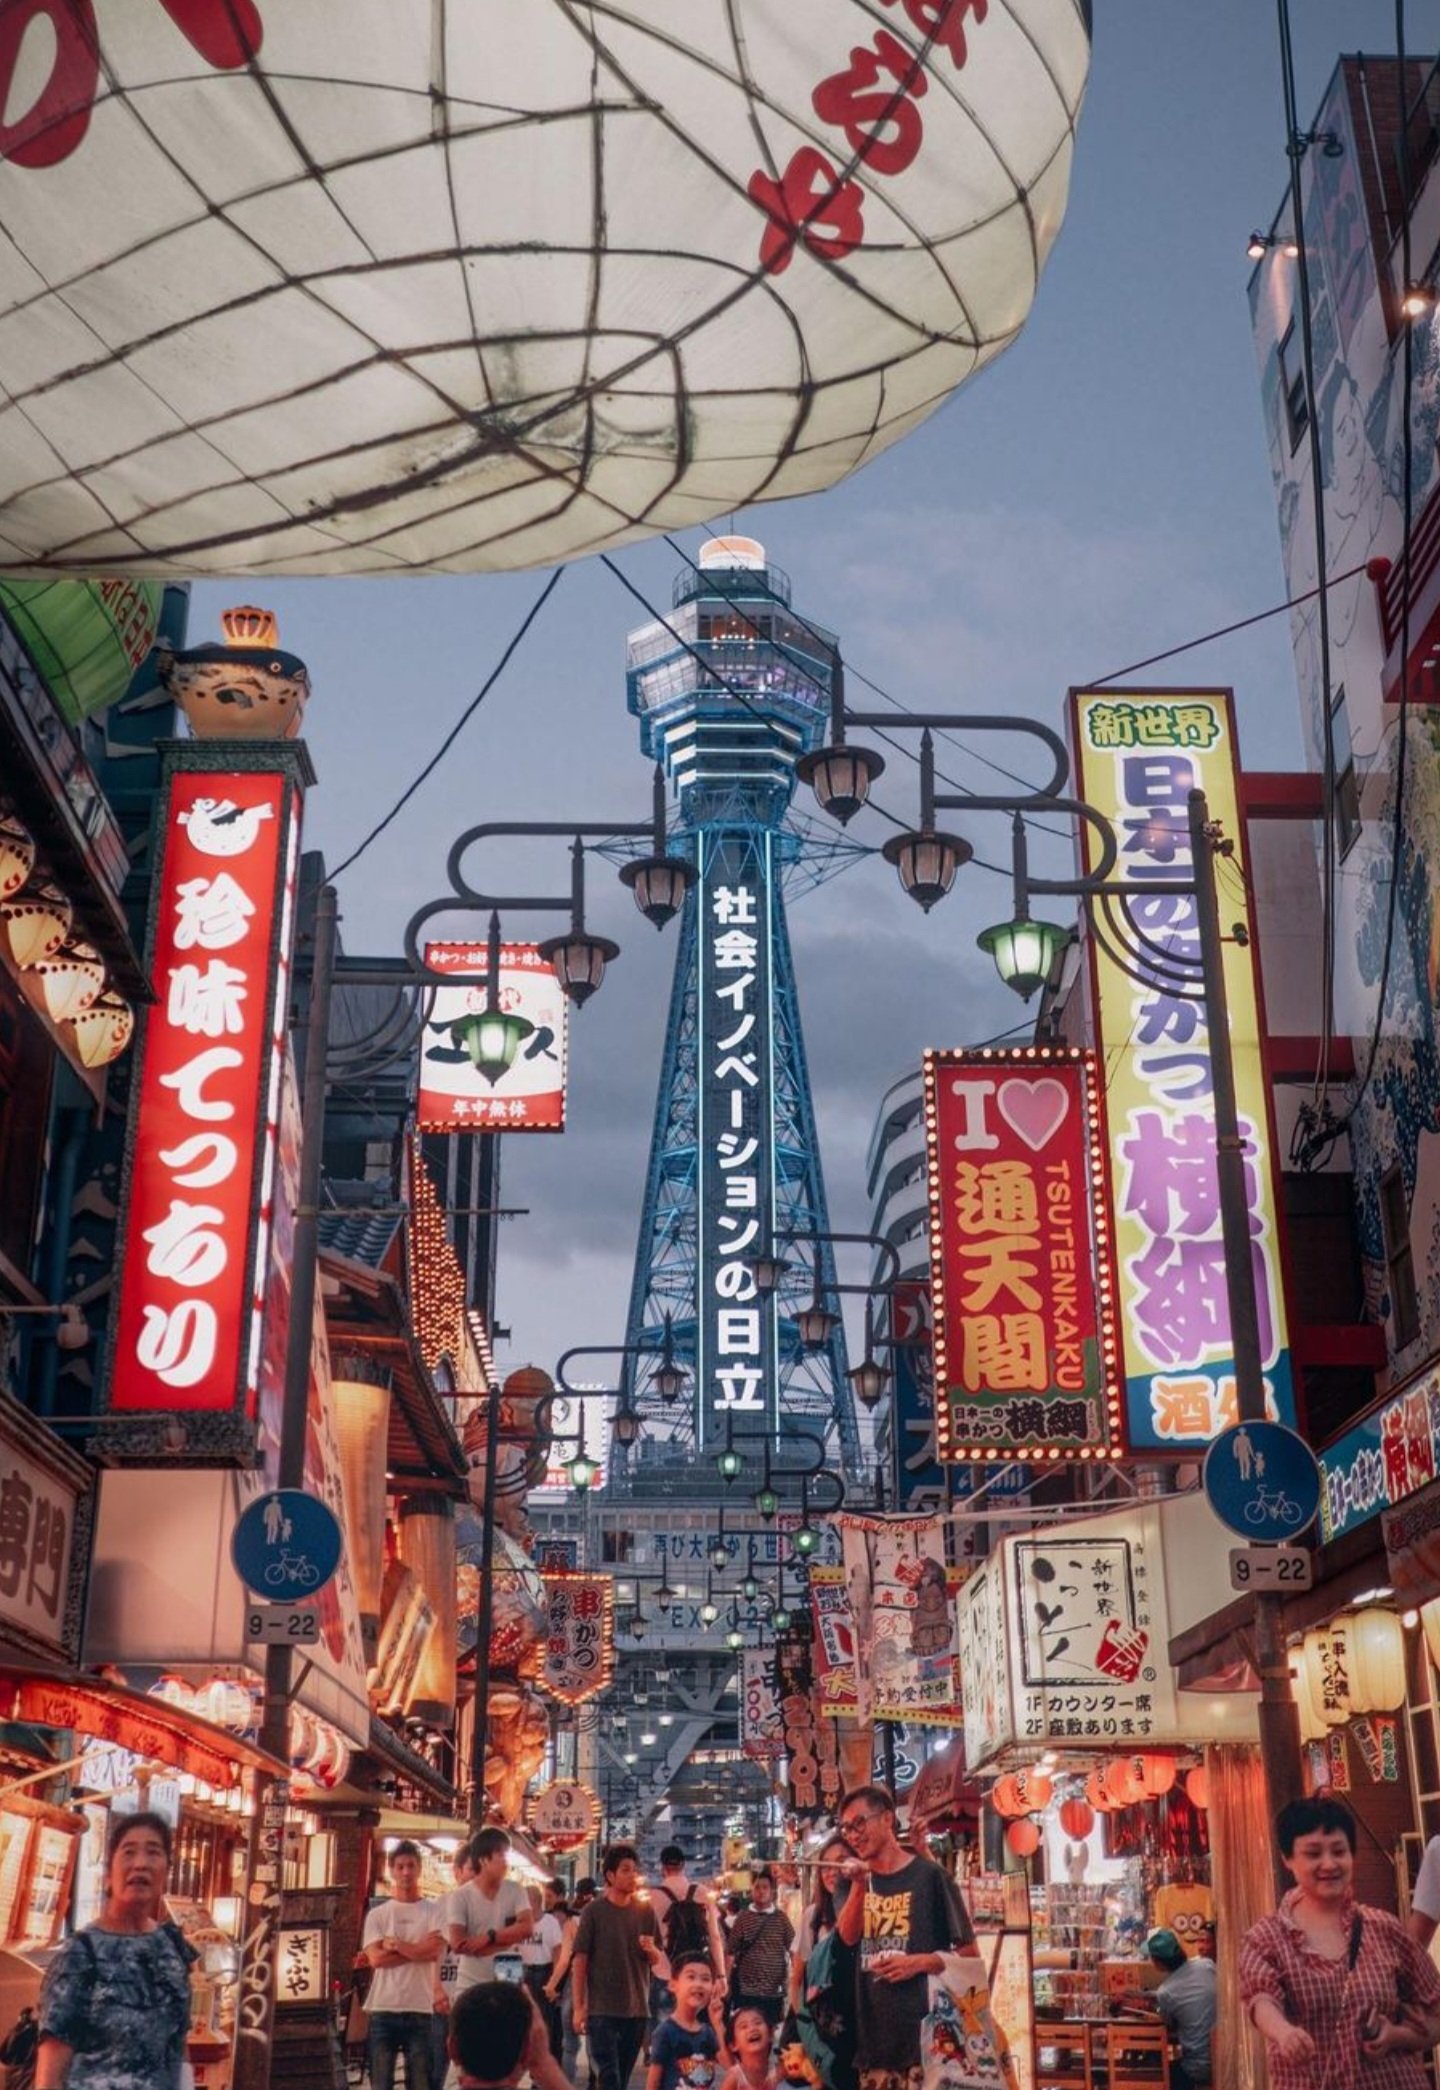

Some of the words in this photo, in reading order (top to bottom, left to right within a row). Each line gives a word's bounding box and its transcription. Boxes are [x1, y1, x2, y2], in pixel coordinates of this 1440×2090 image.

[1089, 702, 1220, 748] 新世界
[135, 872, 257, 1389] 珍味てっちり
[451, 1099, 528, 1118] 年中無休
[712, 885, 765, 1411] 社会イノベーションの日立
[954, 1159, 1049, 1394] 通天閣
[1045, 1158, 1086, 1389] TSUTENKAKU
[954, 1407, 1004, 1420] 日本一の
[955, 1422, 1004, 1439] 串かつ
[1005, 1399, 1088, 1440] 横綱
[572, 1588, 602, 1671] 串かつ
[1025, 1695, 1043, 1711] 1F
[1048, 1694, 1152, 1713] カウンター席
[1025, 1719, 1043, 1736] 2F
[1048, 1718, 1153, 1737] 座敷あります
[285, 1934, 312, 1997] ぎふや
